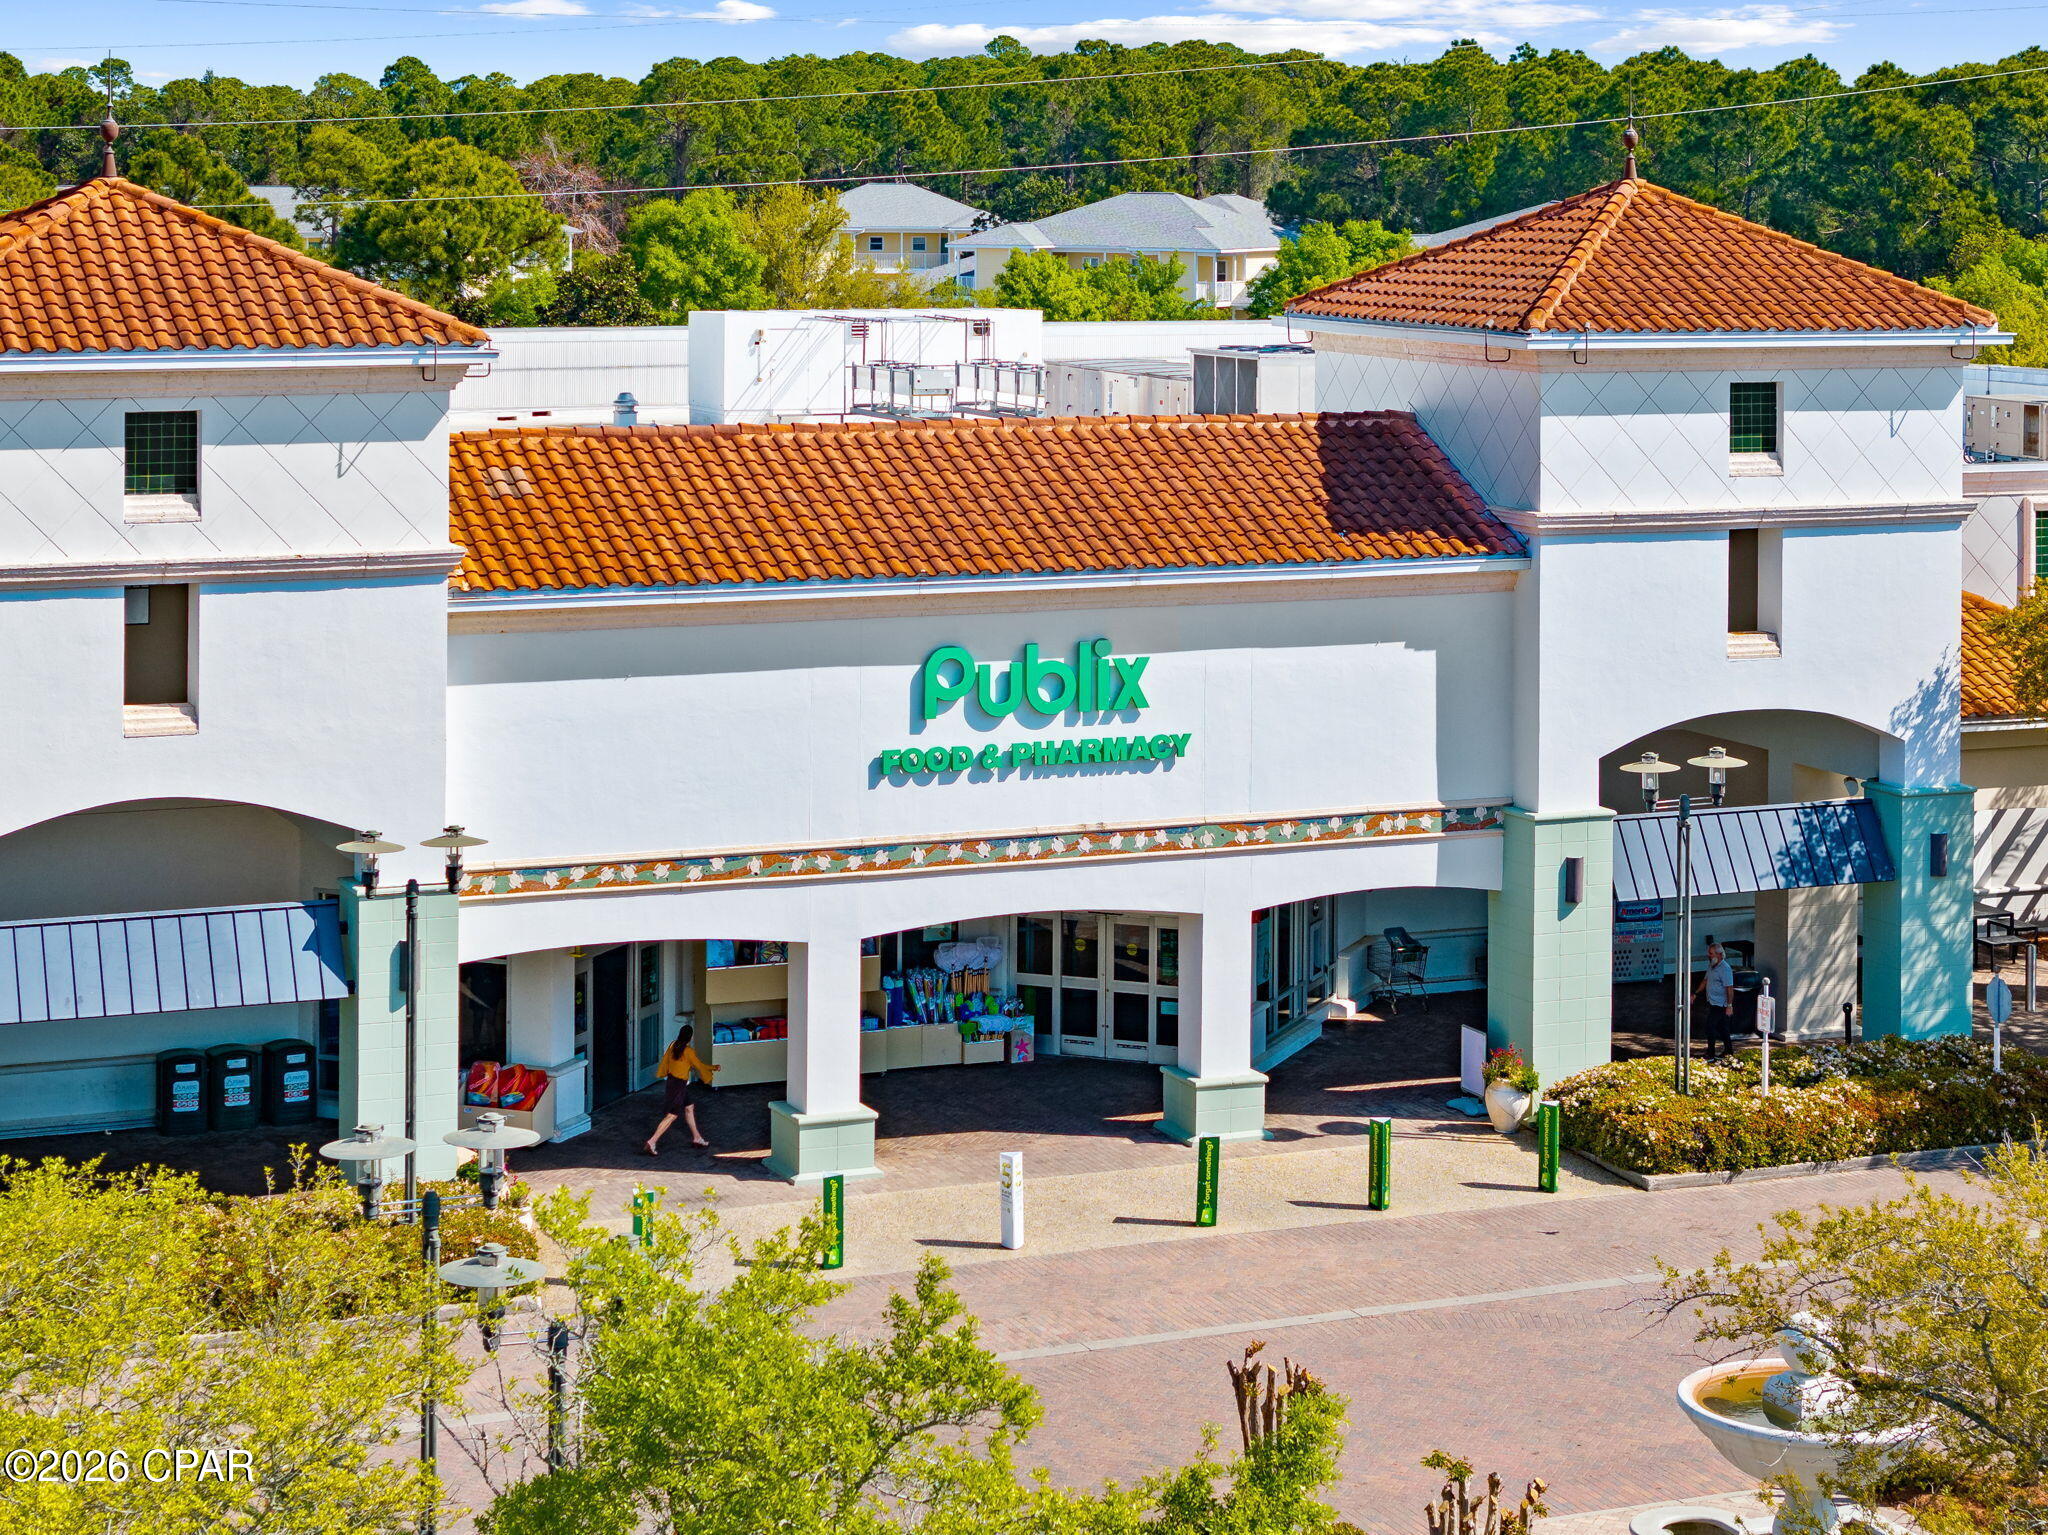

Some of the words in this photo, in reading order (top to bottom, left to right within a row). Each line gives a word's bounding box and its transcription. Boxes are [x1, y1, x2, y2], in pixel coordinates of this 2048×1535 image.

[924, 638, 1150, 720] Publix
[881, 746, 974, 776] FOOD
[982, 744, 1003, 770] &
[1012, 733, 1192, 768] PHARMACY
[1543, 1106, 1551, 1146] something?
[1205, 1140, 1214, 1181] something?
[1203, 1181, 1212, 1205] Forget
